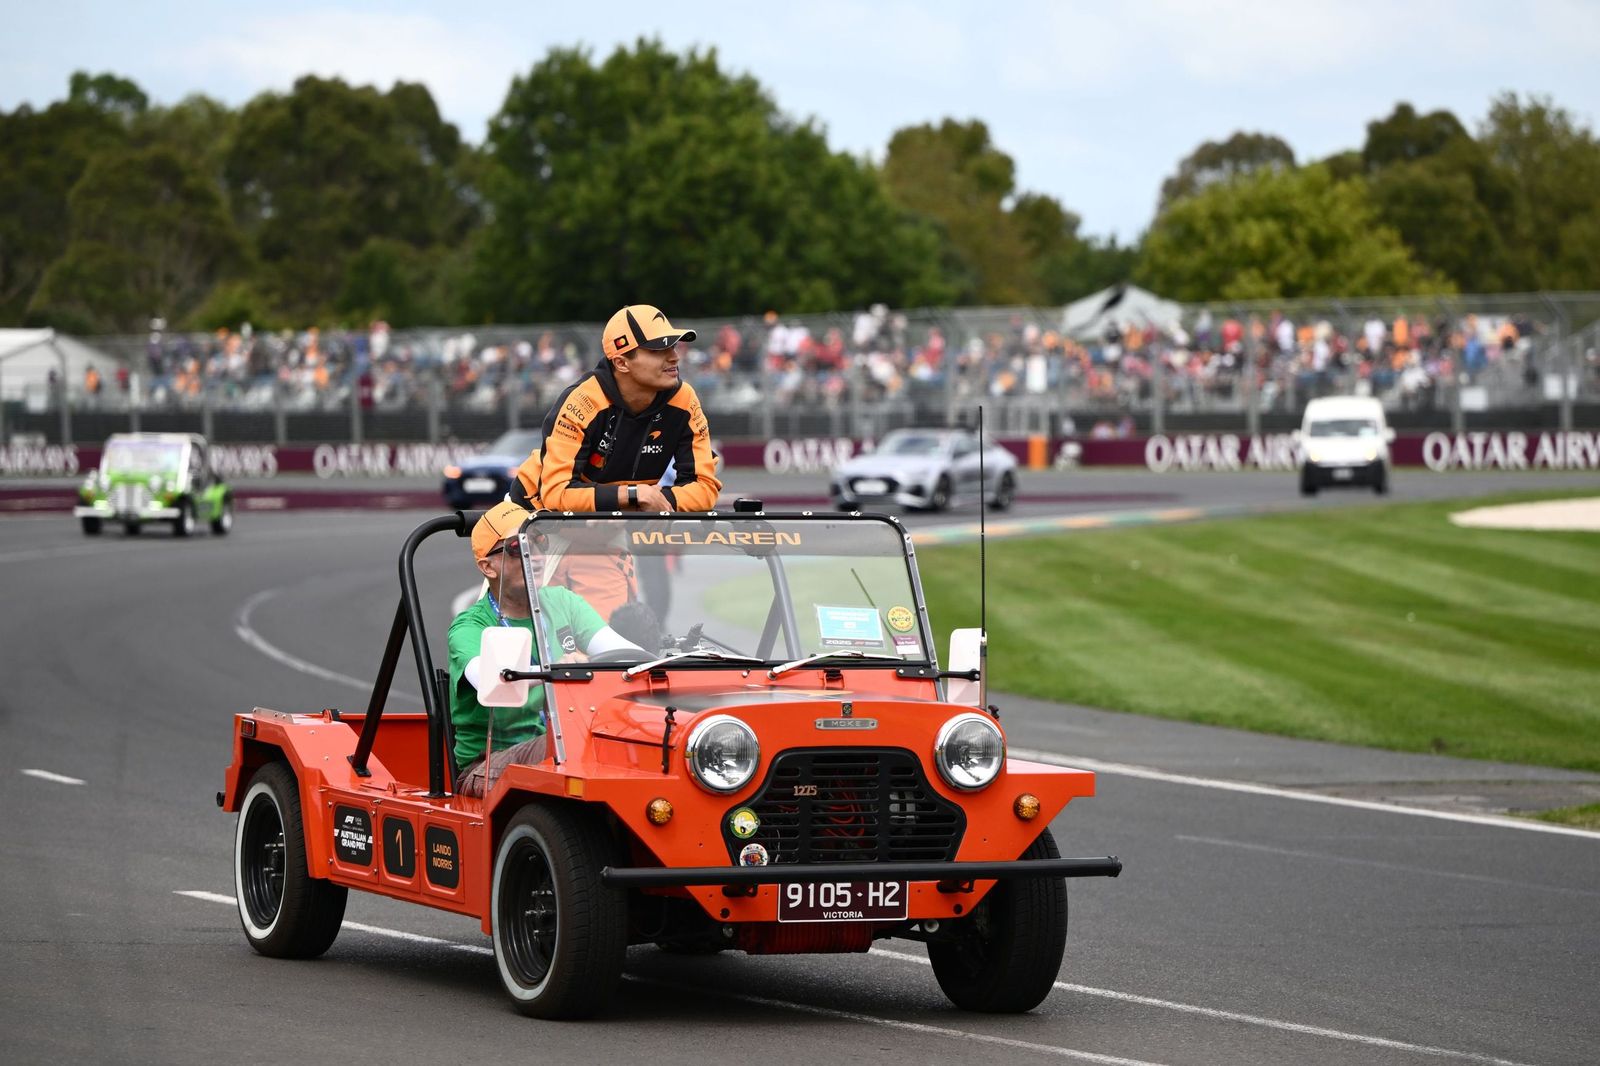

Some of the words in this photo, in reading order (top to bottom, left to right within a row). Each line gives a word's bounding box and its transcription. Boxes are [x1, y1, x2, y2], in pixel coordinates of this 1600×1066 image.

[662, 336, 669, 346] 1
[565, 403, 586, 422] okta
[1144, 433, 1243, 473] QATAR
[1422, 430, 1531, 473] QATAR
[793, 785, 817, 796] 1275
[395, 829, 403, 867] 1
[432, 843, 452, 856] LANDO
[432, 857, 453, 870] NORRIS
[822, 911, 864, 919] VICTORIA
